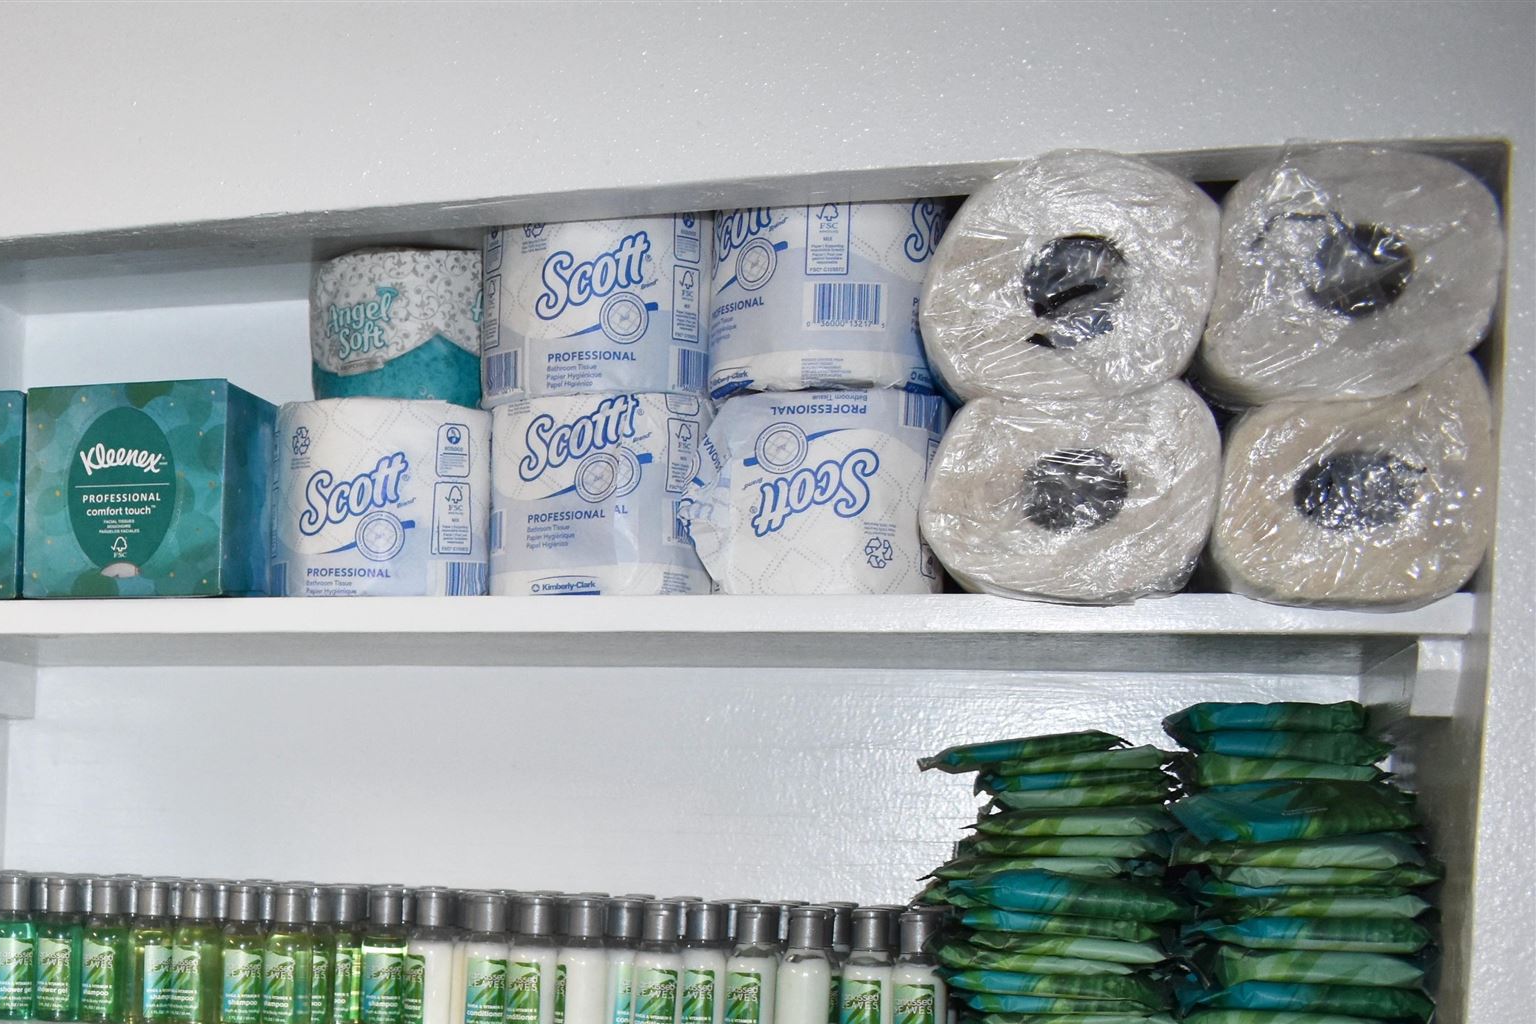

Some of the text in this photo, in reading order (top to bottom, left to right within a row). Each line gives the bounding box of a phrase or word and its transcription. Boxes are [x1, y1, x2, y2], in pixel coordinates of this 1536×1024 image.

[535, 230, 650, 320] Scott
[327, 293, 394, 338] Angel
[340, 322, 385, 359] Soft
[547, 351, 636, 363] PROFESSIONAL
[835, 394, 868, 402] Bathroom
[771, 404, 867, 415] PROFESSIONAL
[80, 443, 162, 475] Kleenex
[83, 493, 161, 503] PROFESSIONAL
[299, 451, 409, 536] Scott
[751, 448, 880, 537] Scott
[527, 510, 605, 523] PROFESSIONAL
[307, 568, 391, 578] PROFESSIONAL
[542, 581, 596, 592] Kimberly-Clark
